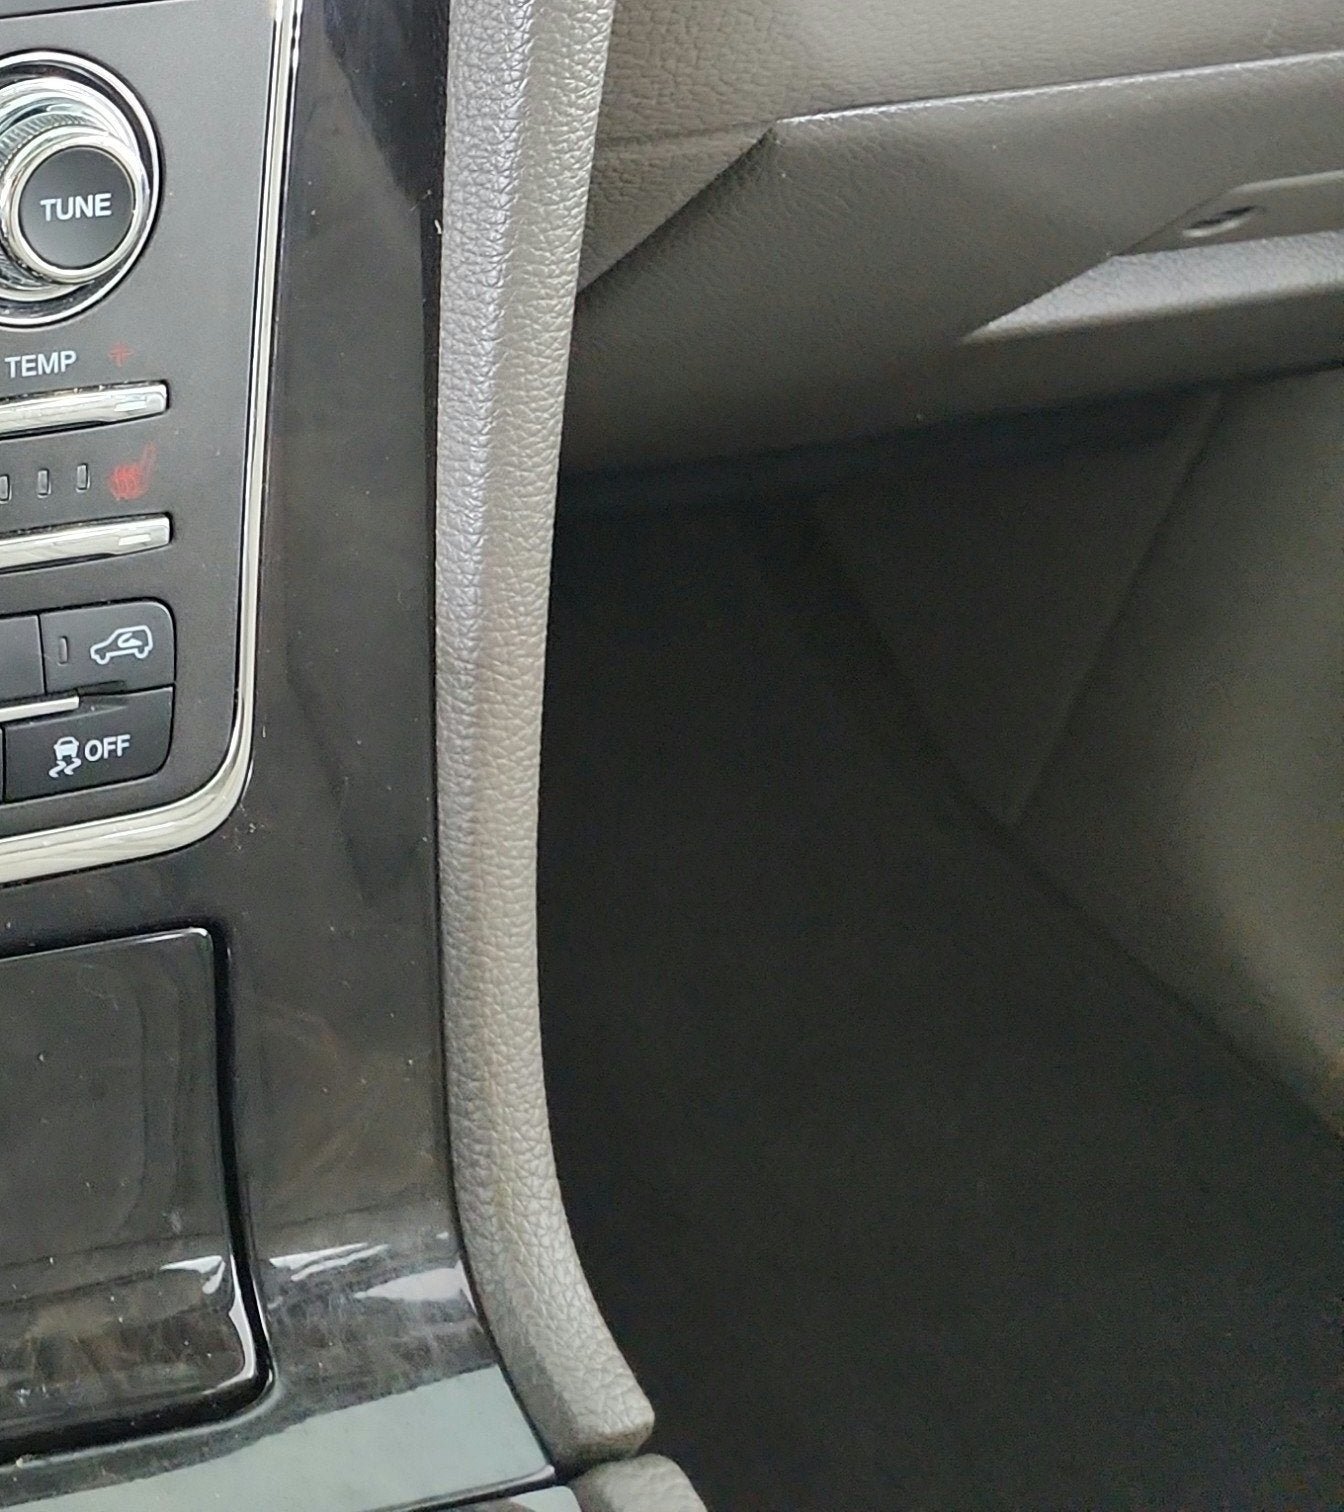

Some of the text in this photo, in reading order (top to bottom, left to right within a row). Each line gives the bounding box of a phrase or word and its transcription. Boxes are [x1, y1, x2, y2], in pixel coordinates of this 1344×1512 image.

[39, 192, 113, 222] TUNE
[4, 350, 78, 379] TEMP
[84, 734, 131, 763] OFF
